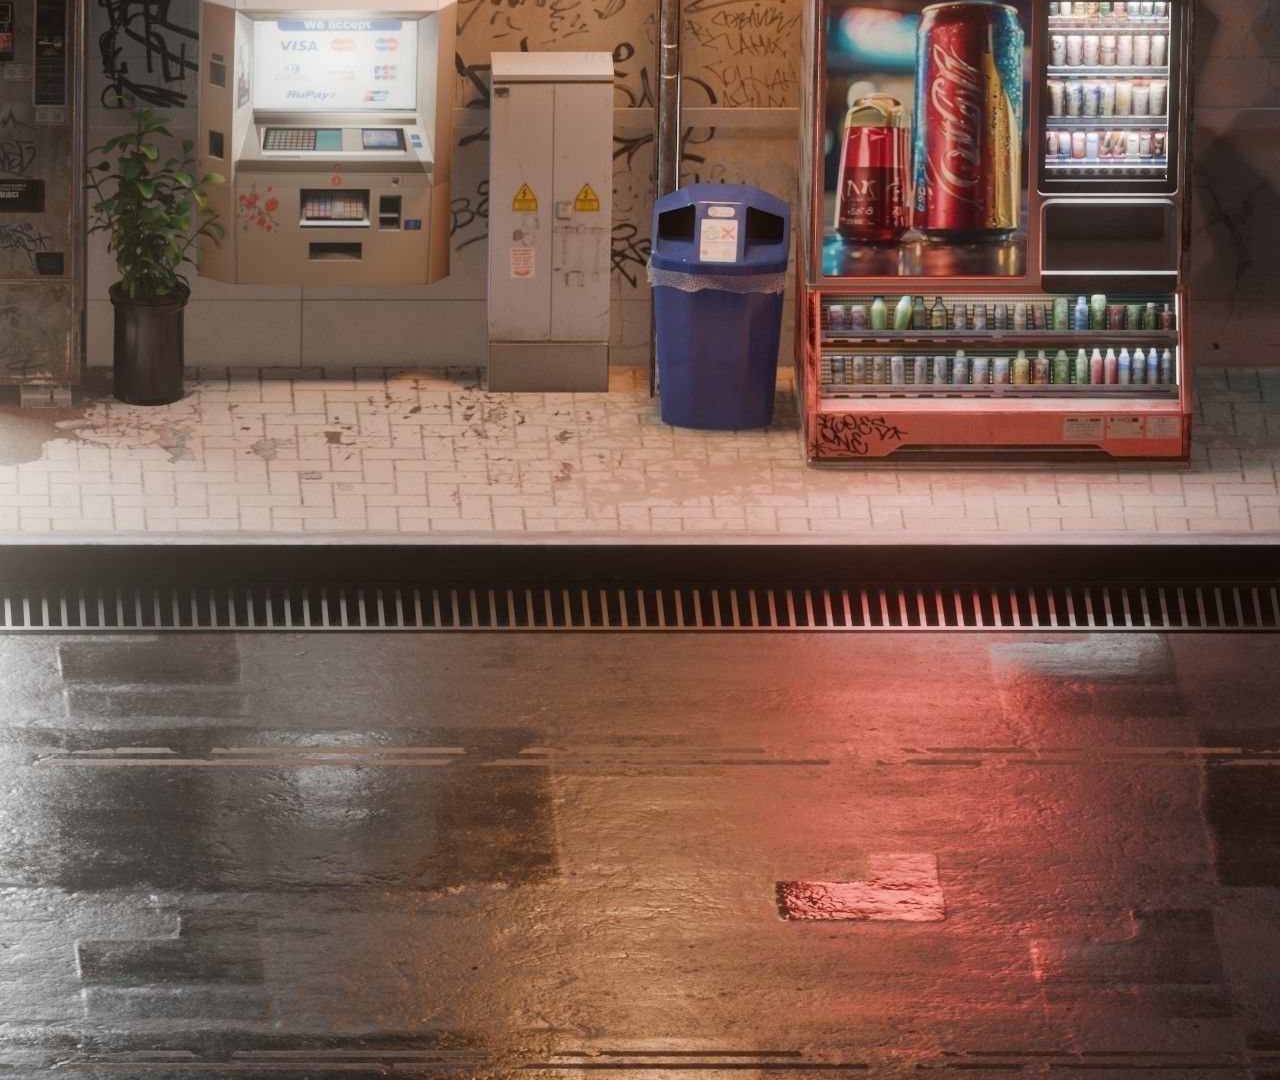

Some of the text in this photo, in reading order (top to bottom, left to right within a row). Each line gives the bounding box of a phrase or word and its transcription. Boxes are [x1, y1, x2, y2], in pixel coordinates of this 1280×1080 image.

[304, 21, 372, 31] We accept
[280, 40, 319, 52] VISA
